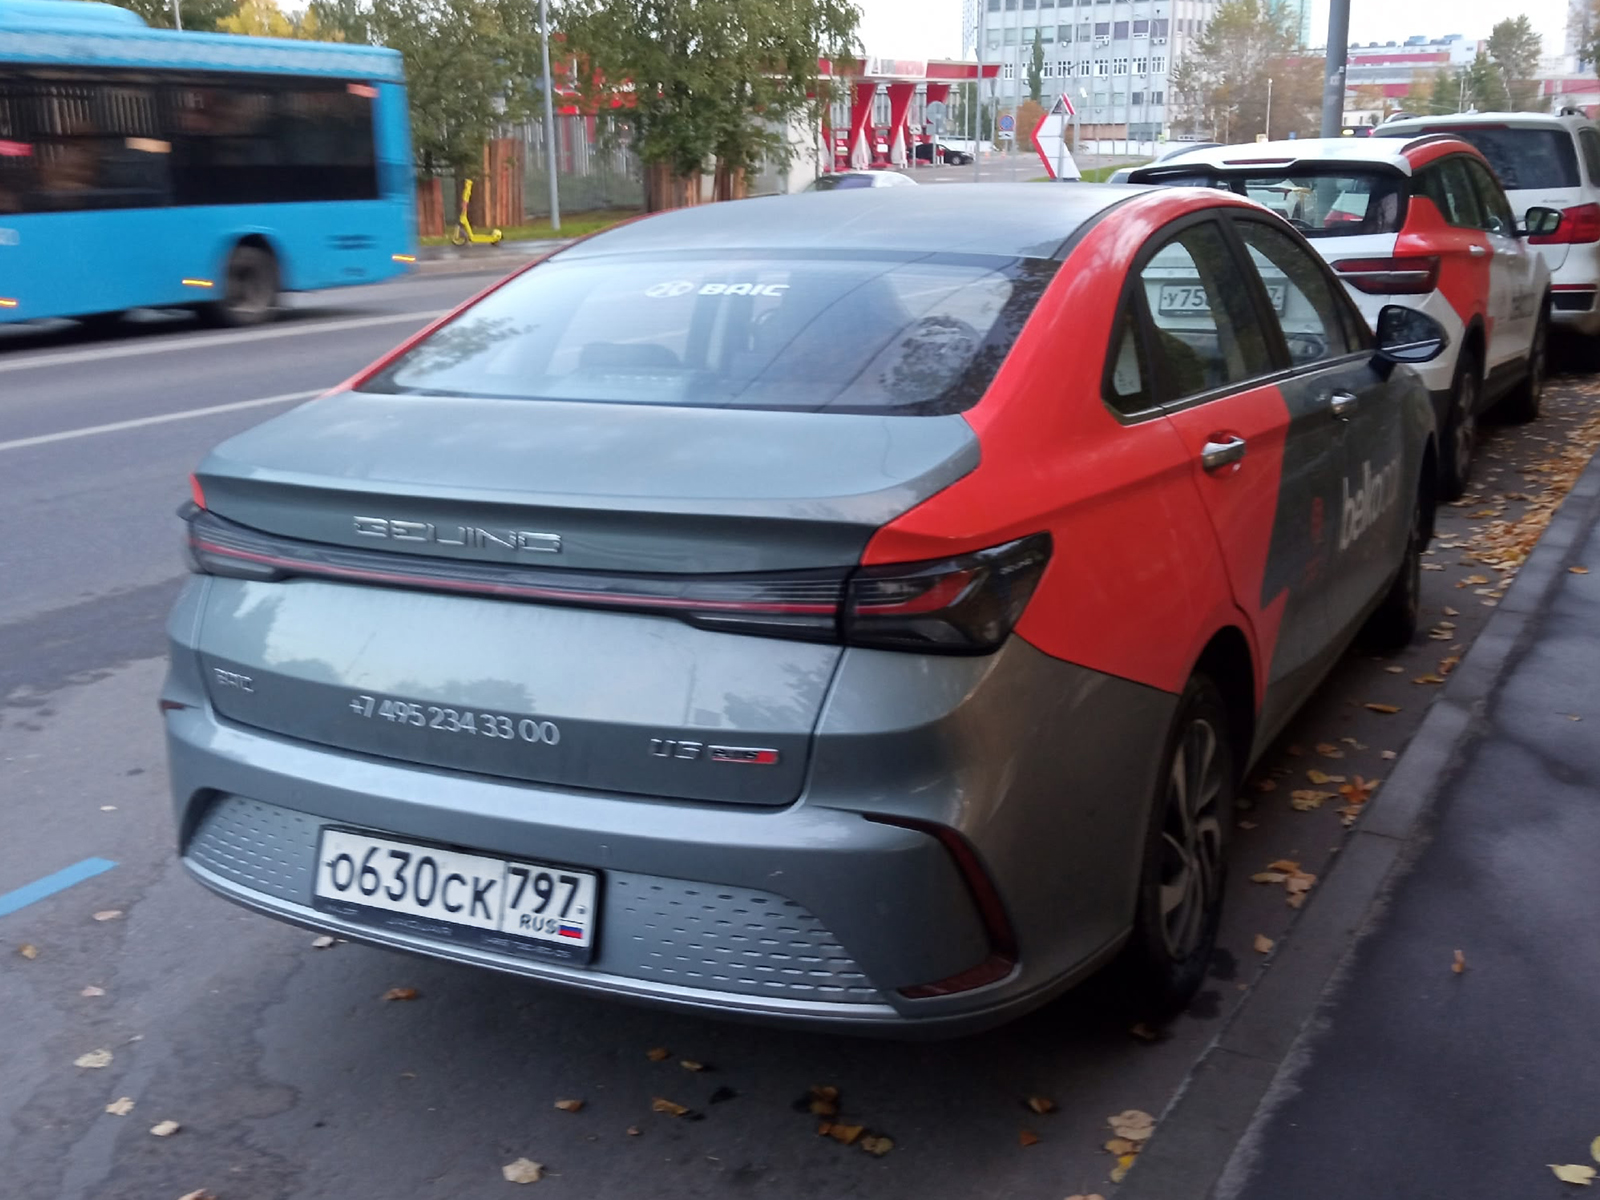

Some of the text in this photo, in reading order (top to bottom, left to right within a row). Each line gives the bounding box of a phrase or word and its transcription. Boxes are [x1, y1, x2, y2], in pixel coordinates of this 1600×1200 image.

[696, 283, 791, 297] BAIC
[1168, 288, 1208, 308] У75
[353, 514, 563, 555] BEIJING
[349, 695, 561, 746] +7 495 234 33 00
[507, 866, 580, 919] 797
[519, 913, 558, 935] RUS
